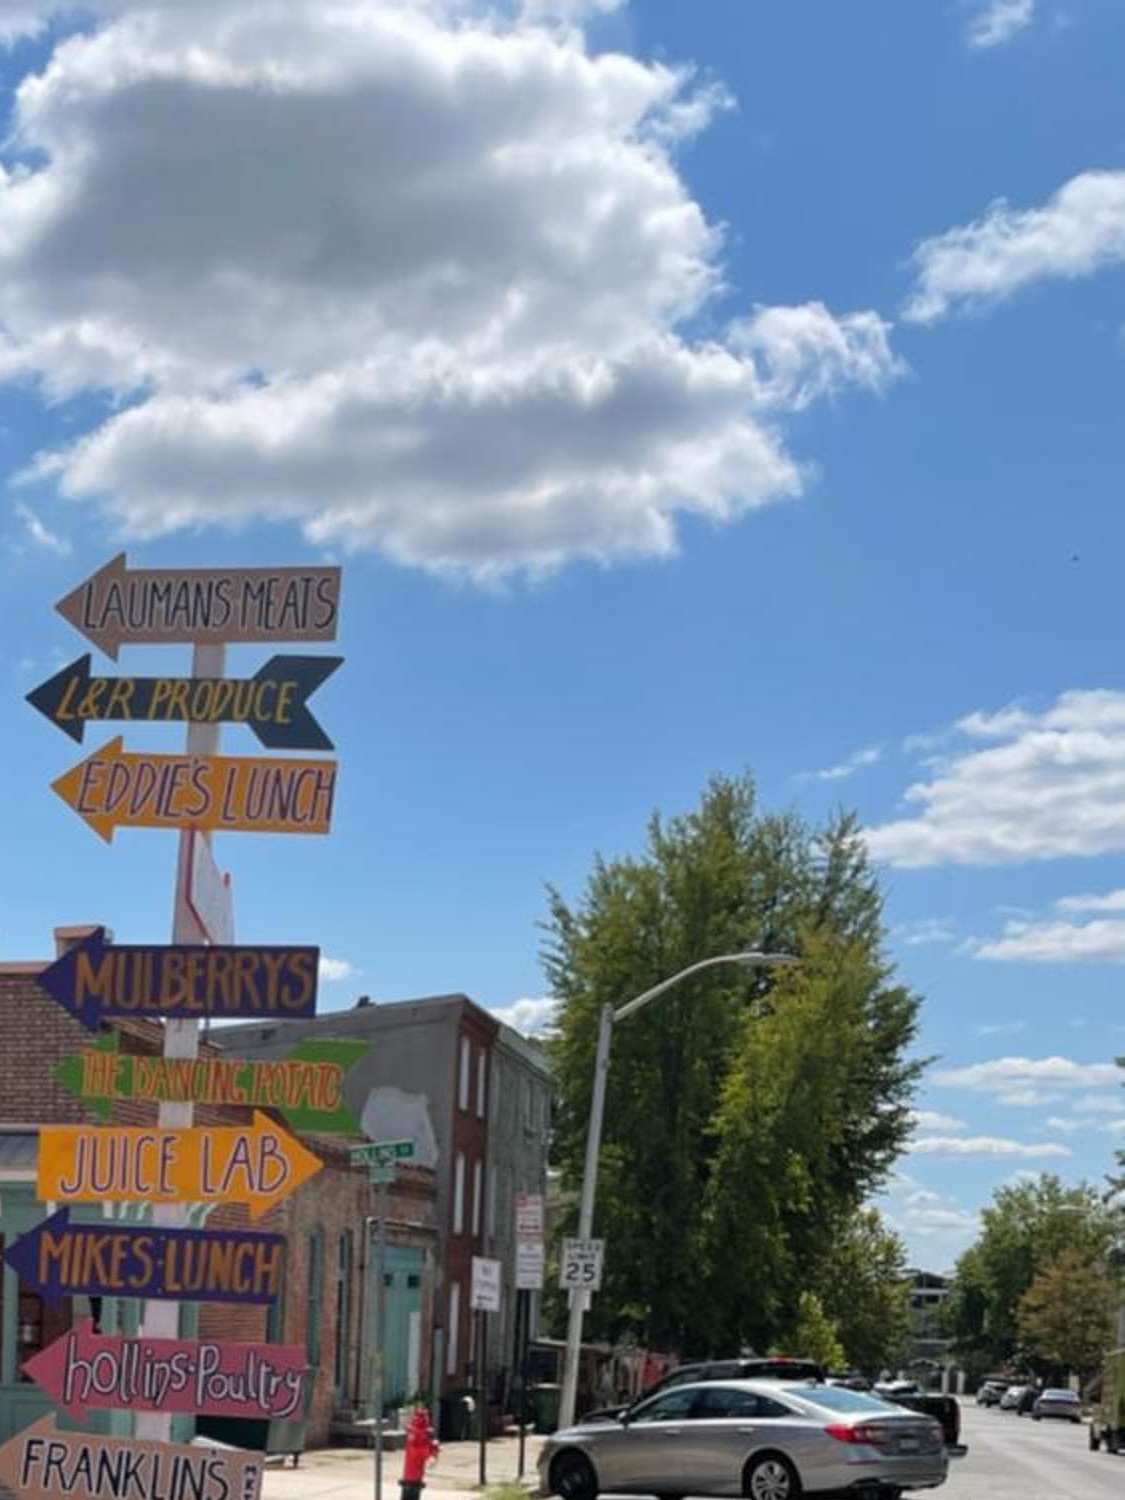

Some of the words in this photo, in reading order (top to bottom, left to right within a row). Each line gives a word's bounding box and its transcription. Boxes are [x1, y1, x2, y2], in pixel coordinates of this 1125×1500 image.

[82, 579, 232, 630] LAUMANS
[241, 576, 337, 629] MEATS
[56, 676, 134, 721] L&R
[148, 680, 297, 724] PRODUCE
[77, 757, 210, 819] EDDIE'S
[222, 766, 336, 823] LUNCH
[75, 949, 313, 1011] MULBERRYS
[80, 1049, 123, 1098] THE
[132, 1056, 250, 1103] DANCING
[252, 1060, 343, 1111] POTATO
[59, 1134, 179, 1194] JUICE
[201, 1133, 290, 1194] LAB
[164, 1238, 283, 1296] LUNCH
[565, 1262, 595, 1282] 25
